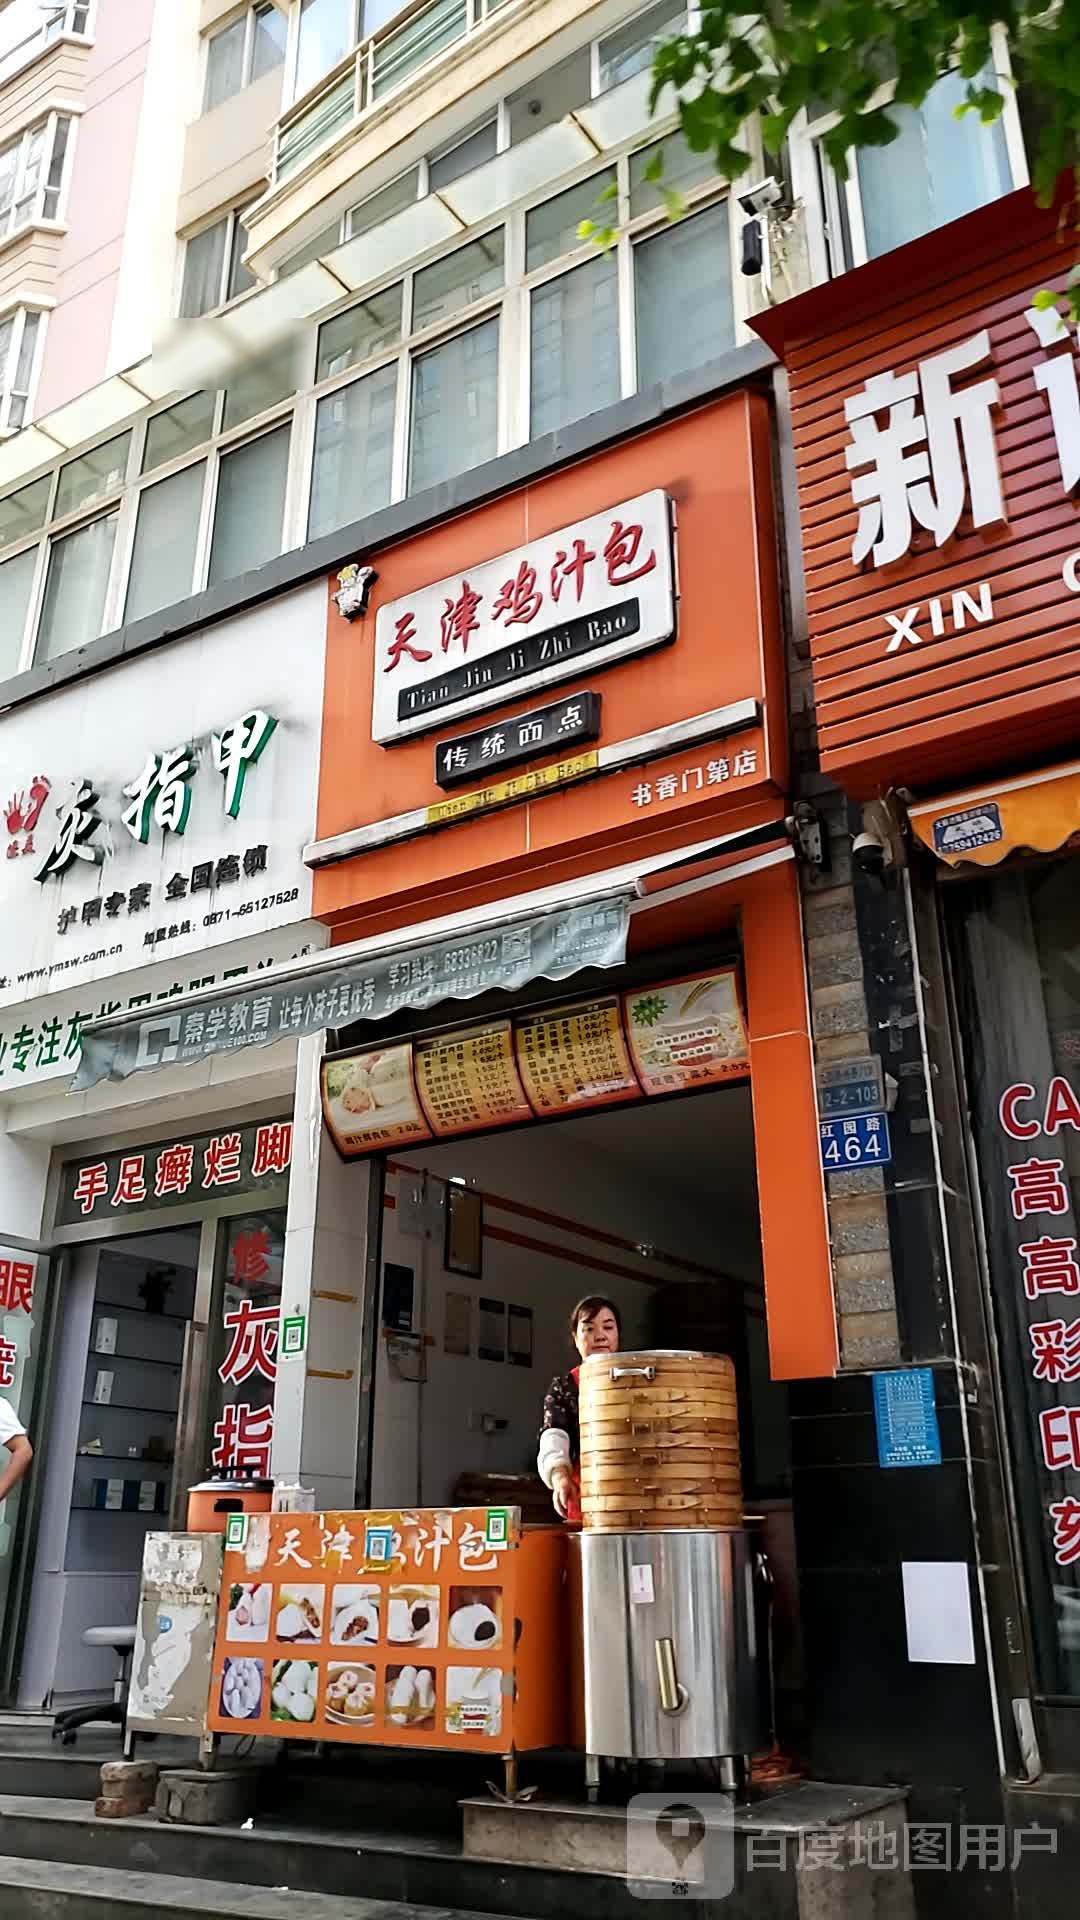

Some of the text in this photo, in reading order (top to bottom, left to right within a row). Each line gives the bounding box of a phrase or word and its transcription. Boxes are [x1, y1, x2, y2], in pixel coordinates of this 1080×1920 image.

[384, 520, 657, 673] 天津鸡汁包
[885, 583, 995, 653] XIN
[406, 613, 628, 710] Tian Jin Ji Zhi Bao
[442, 703, 585, 774] 传统面点
[631, 749, 758, 808] 书香门第店
[34, 709, 279, 883] 灰指甲
[57, 844, 269, 935] 护甲专家 全国连锁
[74, 1121, 294, 1214] 手足癣烂脚
[824, 1134, 882, 1163] 464
